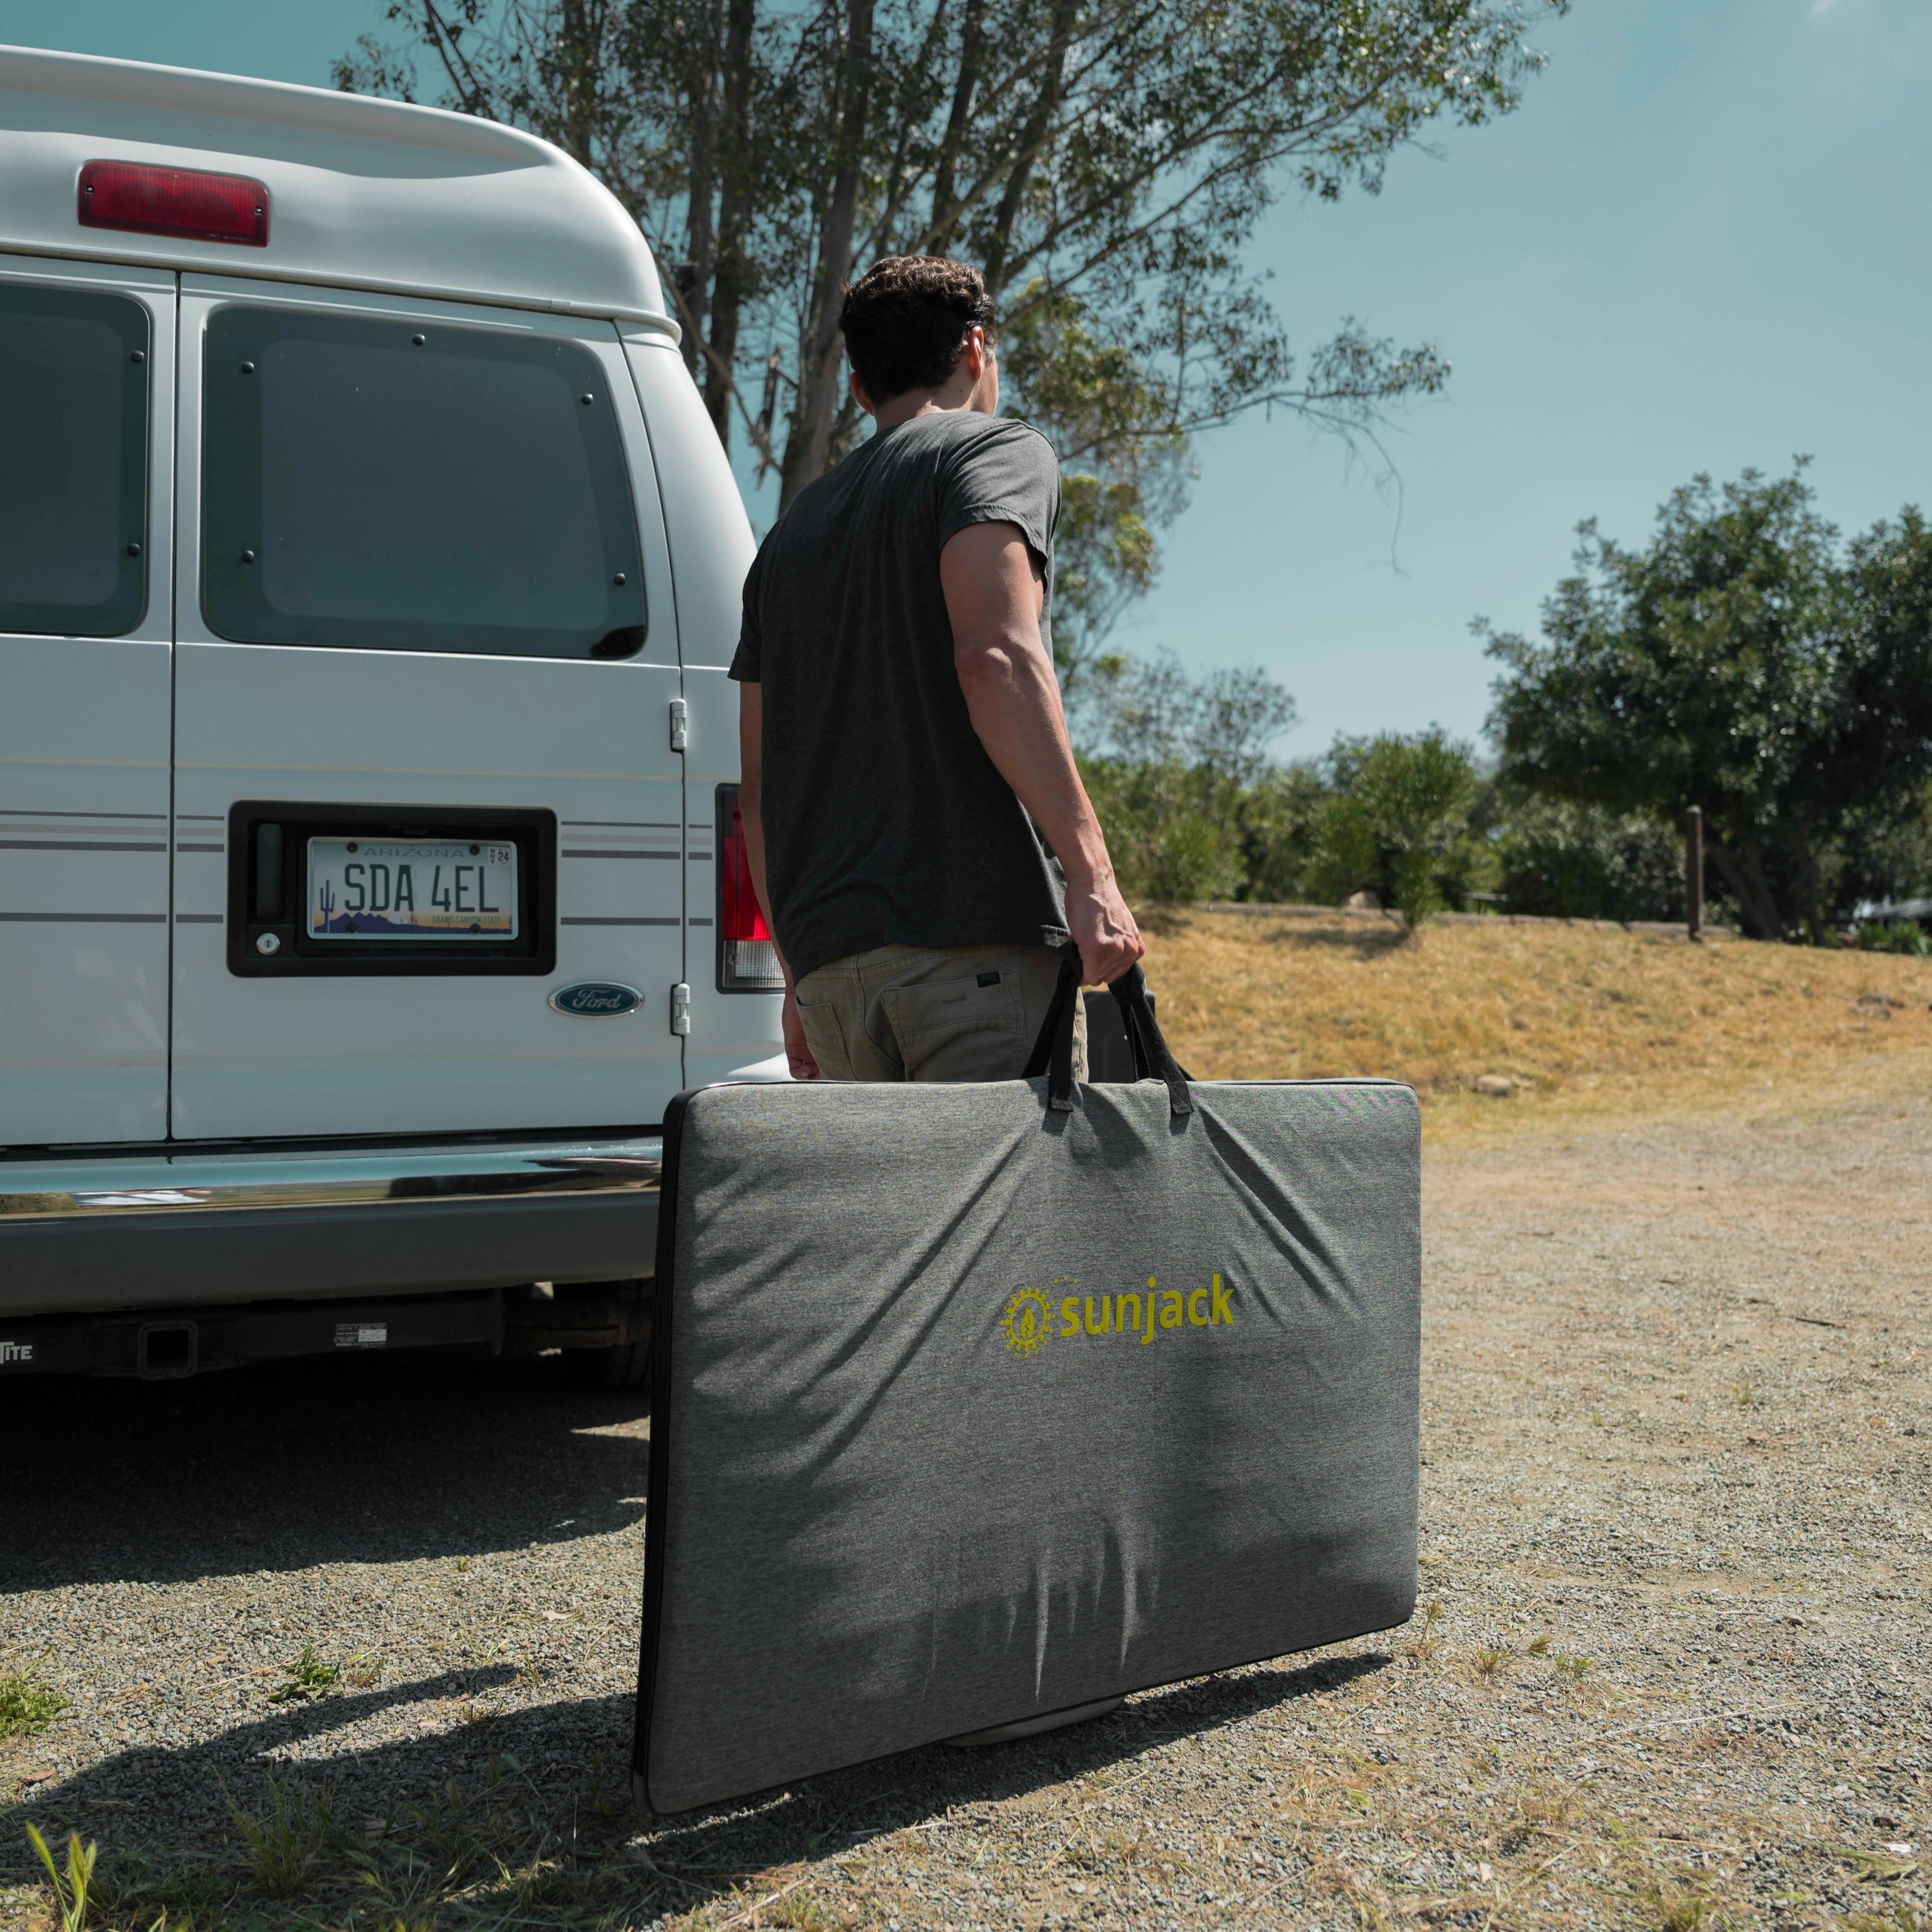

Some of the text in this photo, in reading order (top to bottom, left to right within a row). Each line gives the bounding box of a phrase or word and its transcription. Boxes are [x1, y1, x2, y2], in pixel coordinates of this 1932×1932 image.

[364, 847, 465, 858] ARIZONA
[498, 851, 509, 861] 24
[344, 863, 500, 913] SDA 4EL
[456, 915, 481, 924] CANYON
[483, 915, 500, 924] STATE
[572, 989, 622, 1009] Ford
[1059, 1273, 1234, 1346] sunjack
